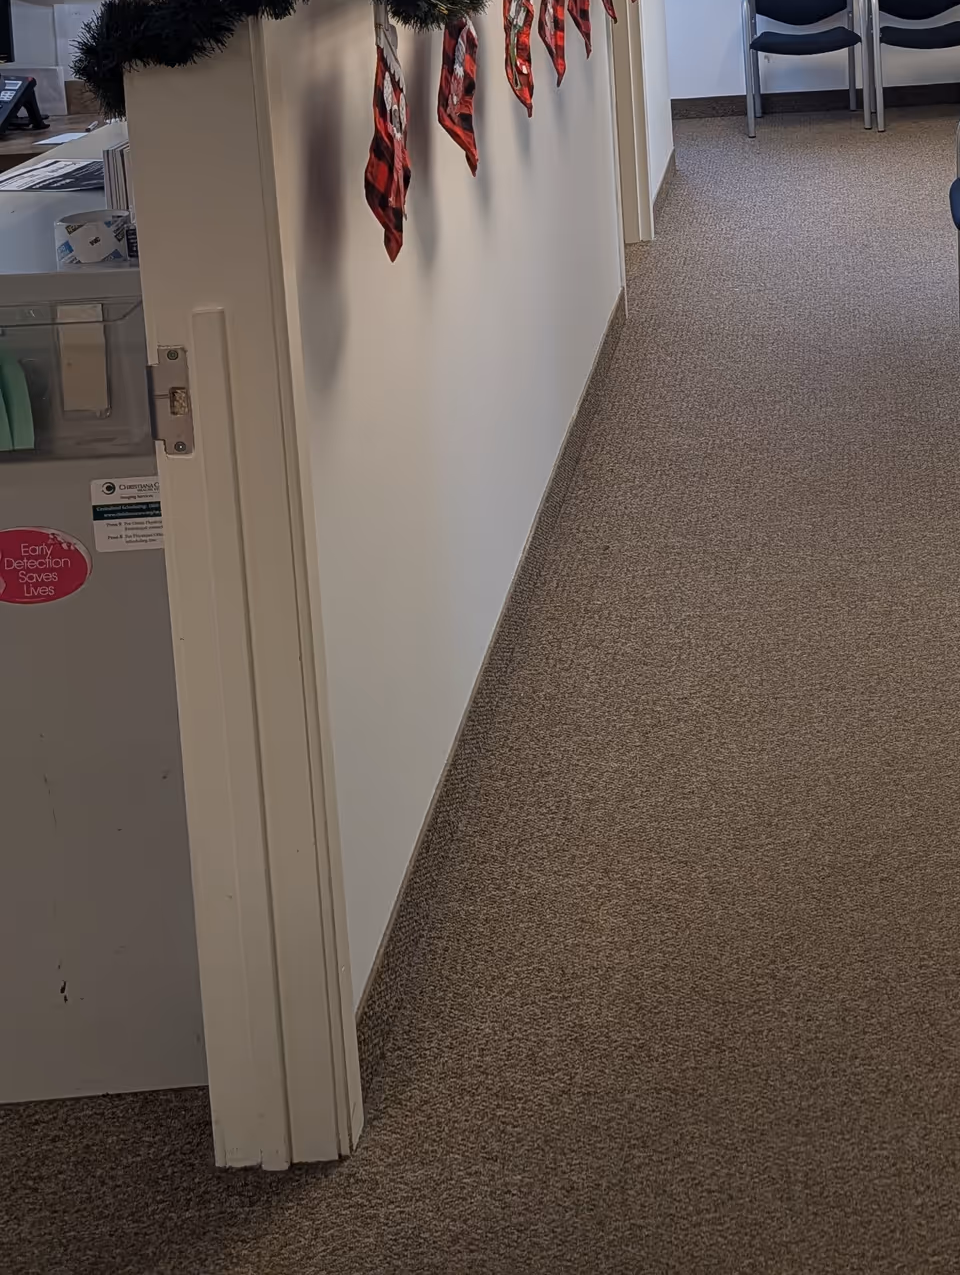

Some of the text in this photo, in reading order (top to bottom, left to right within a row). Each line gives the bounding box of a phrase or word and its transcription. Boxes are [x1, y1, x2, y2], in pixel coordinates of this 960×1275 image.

[21, 543, 54, 558] Early
[4, 556, 71, 570] Detection
[18, 570, 58, 583] Saves
[24, 584, 55, 597] Lives
